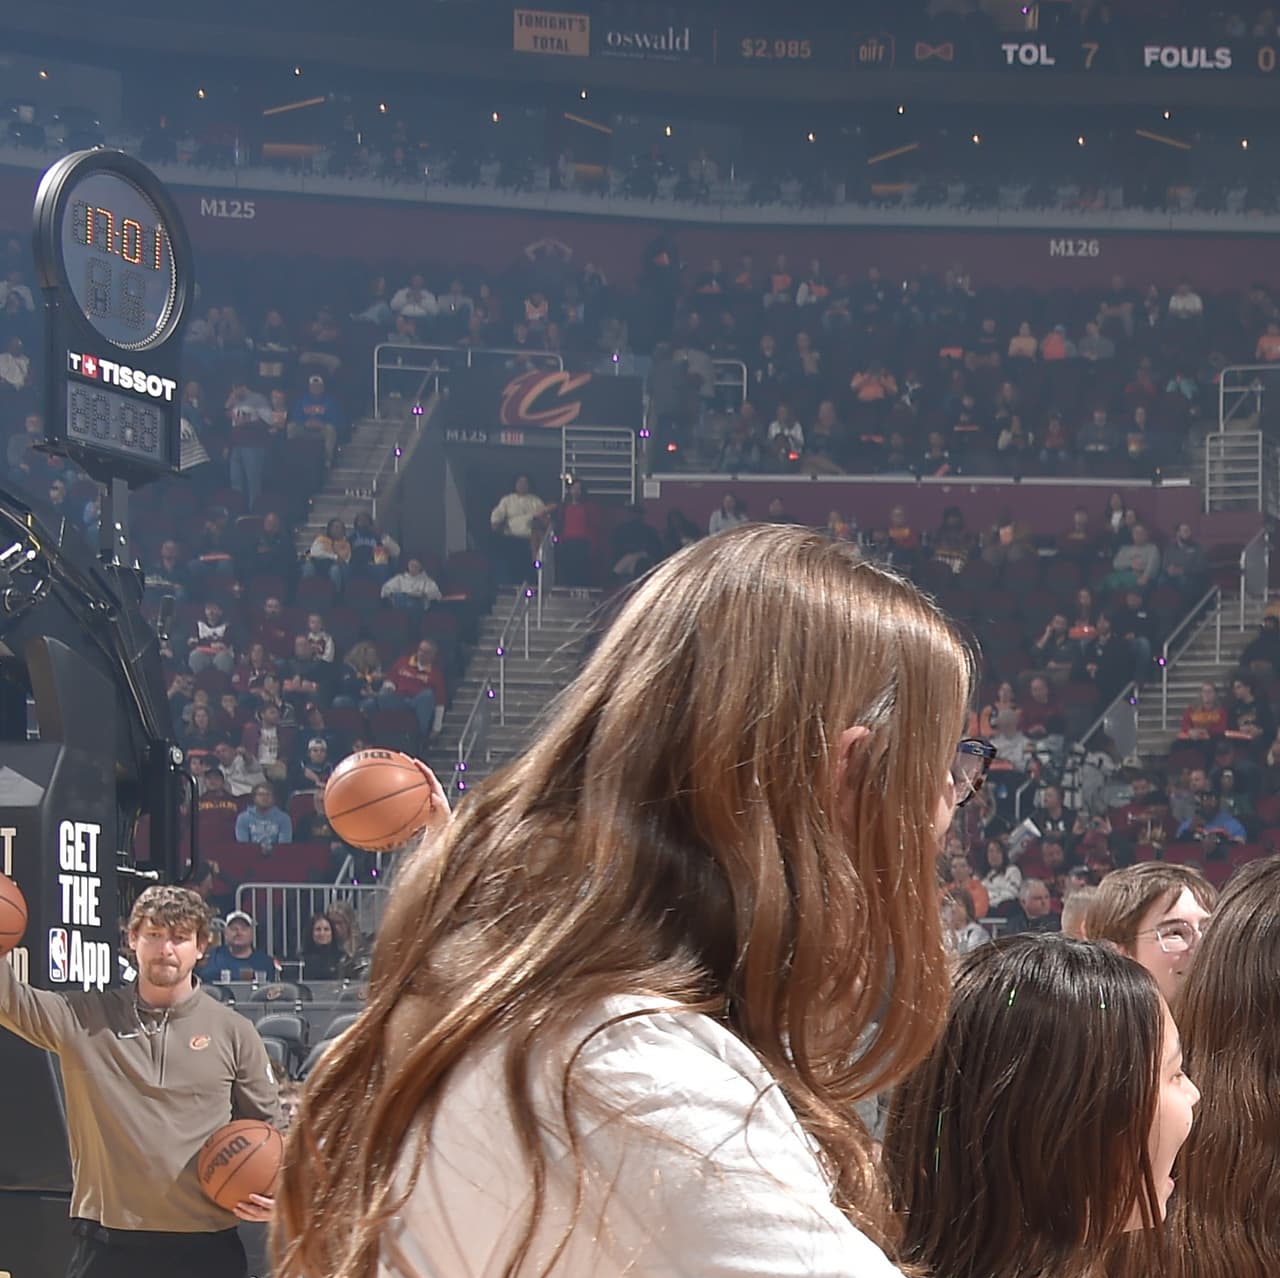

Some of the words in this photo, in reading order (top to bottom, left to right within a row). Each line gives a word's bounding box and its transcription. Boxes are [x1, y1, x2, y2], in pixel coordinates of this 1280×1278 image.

[532, 35, 570, 51] TOTAL
[607, 27, 690, 51] oswald
[1002, 43, 1056, 65] TOL
[1144, 46, 1232, 68] FOULS
[1257, 47, 1276, 71] 0
[201, 199, 255, 219] M125
[86, 206, 162, 270] 17:01
[1050, 239, 1099, 257] M126
[99, 359, 176, 400] TISSOT
[59, 820, 101, 873] GET
[59, 874, 101, 927] THE
[69, 930, 111, 992] App
[203, 1134, 252, 1185] Wilson
